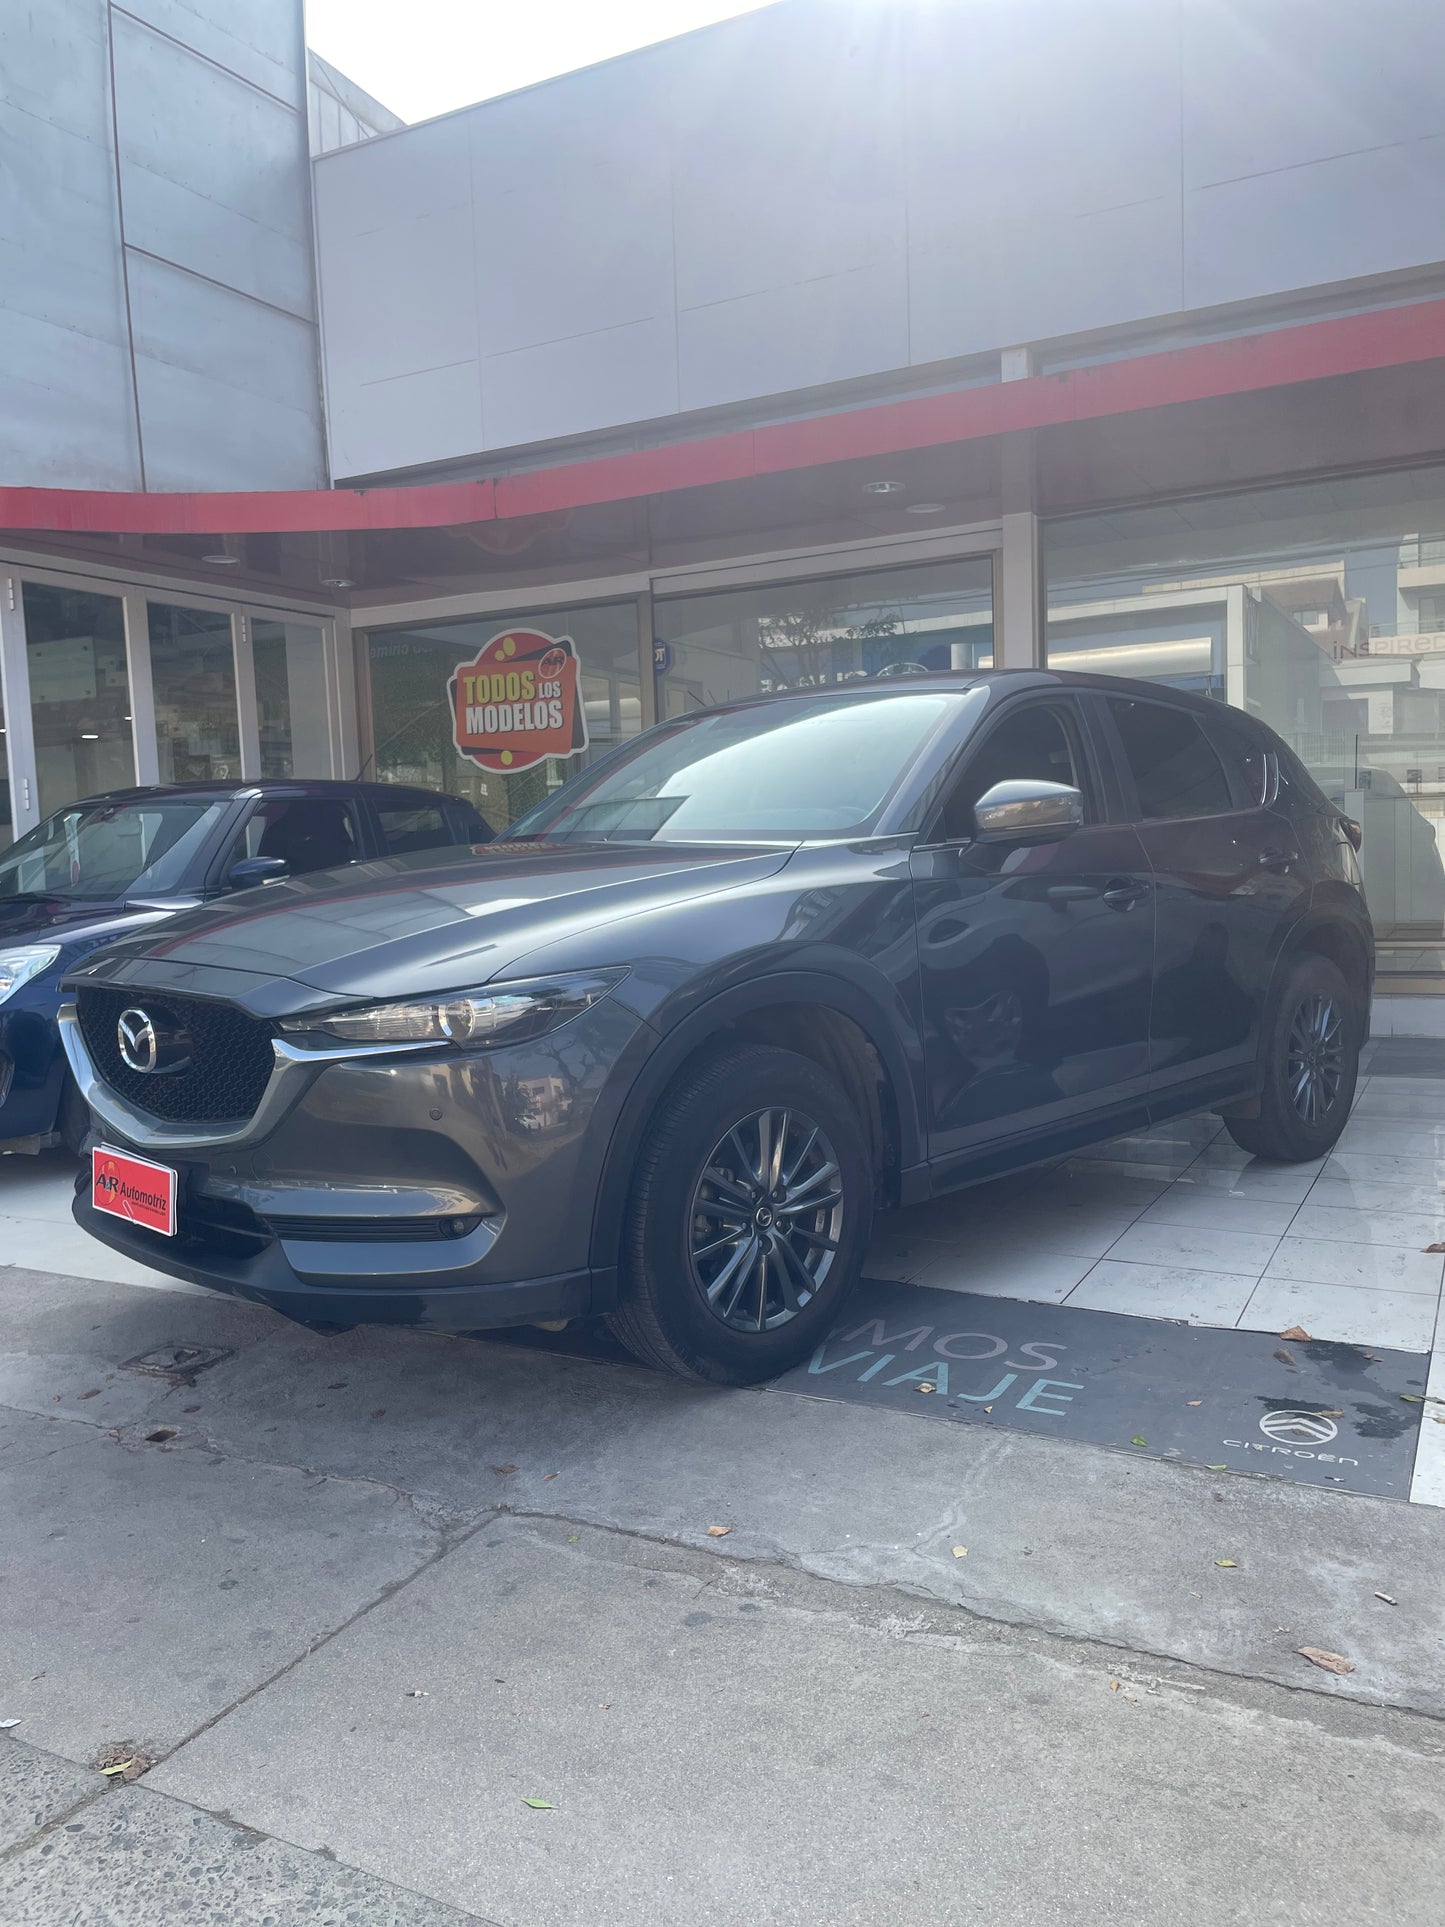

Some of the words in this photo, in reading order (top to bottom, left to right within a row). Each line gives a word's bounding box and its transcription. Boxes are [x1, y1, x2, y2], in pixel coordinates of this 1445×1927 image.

[463, 671, 536, 705] TODOS
[538, 681, 562, 699] LOS
[465, 700, 564, 735] MODELOS
[120, 1182, 167, 1211] Automotriz
[825, 1318, 1068, 1371] MOS
[807, 1345, 1085, 1416] VIAJE
